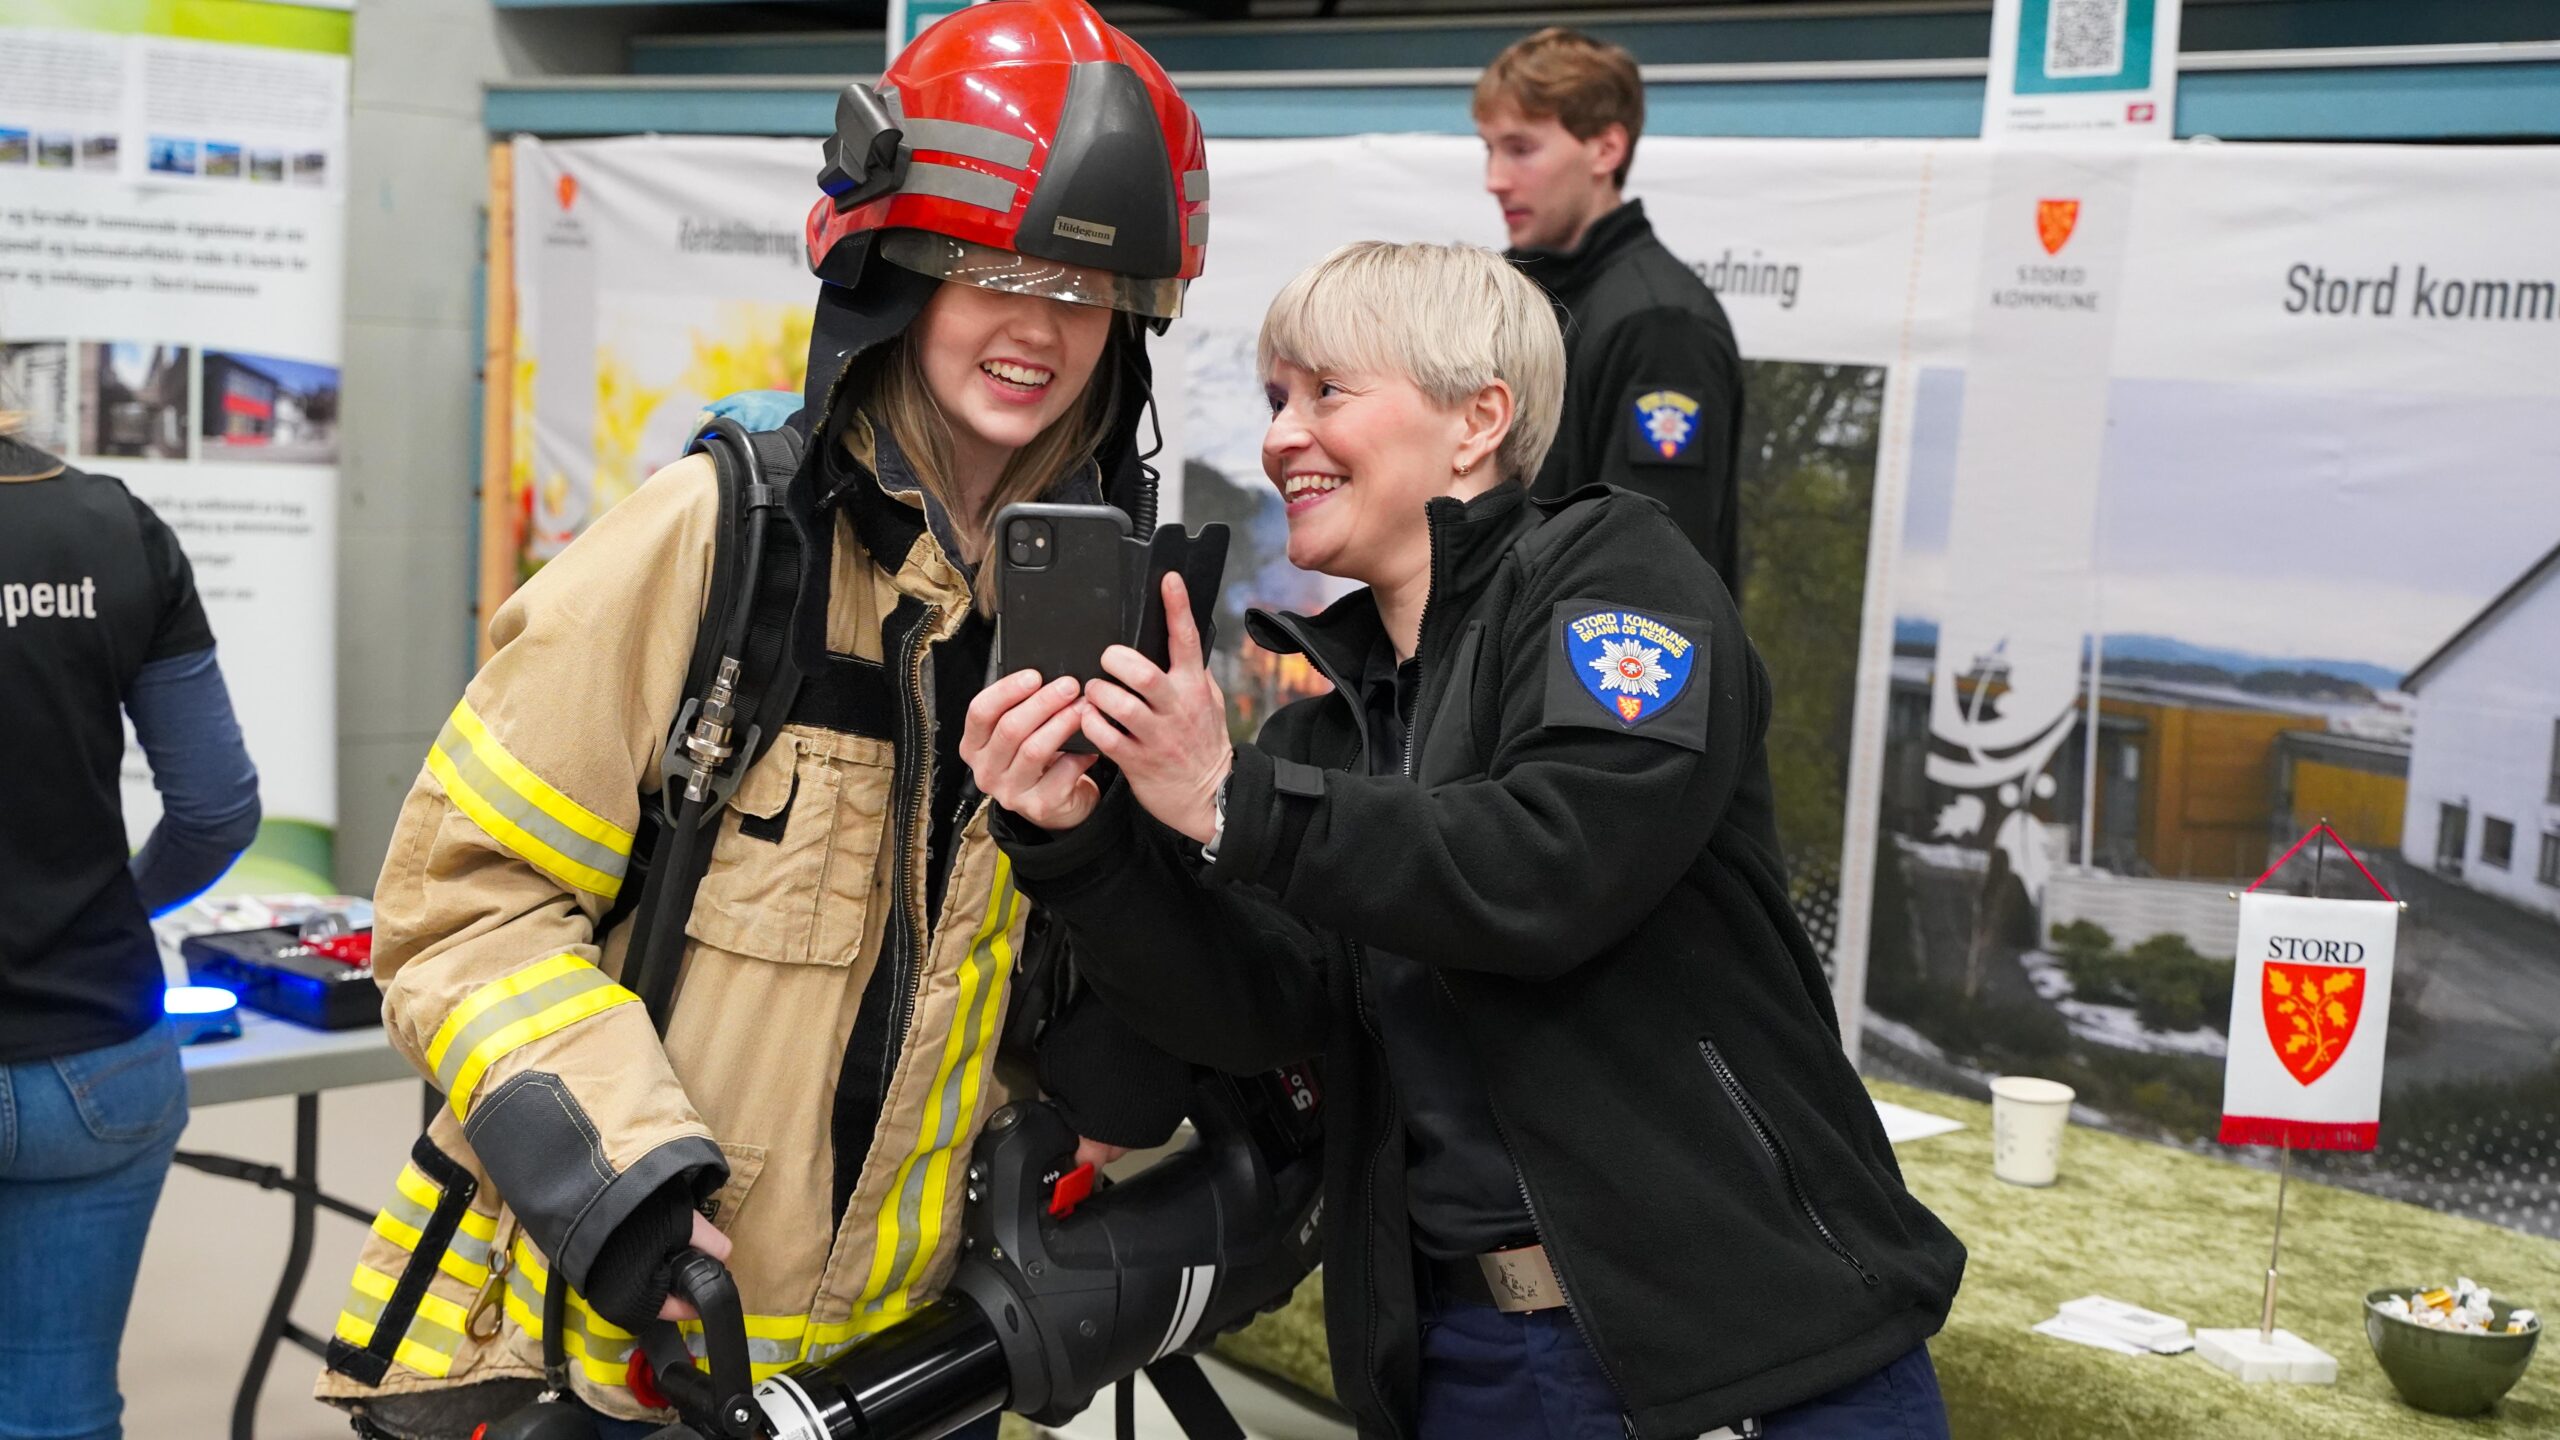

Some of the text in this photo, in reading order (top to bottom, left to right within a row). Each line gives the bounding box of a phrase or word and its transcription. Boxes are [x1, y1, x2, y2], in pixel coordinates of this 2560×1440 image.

[1058, 221, 1111, 241] Hildegunn
[2285, 264, 2560, 320] Stord komm
[0, 576, 97, 628] peut
[1571, 613, 1691, 652] STORD KOMMUNE
[1579, 624, 1683, 659] BRANN OG REDNING
[2267, 935, 2365, 964] STORD
